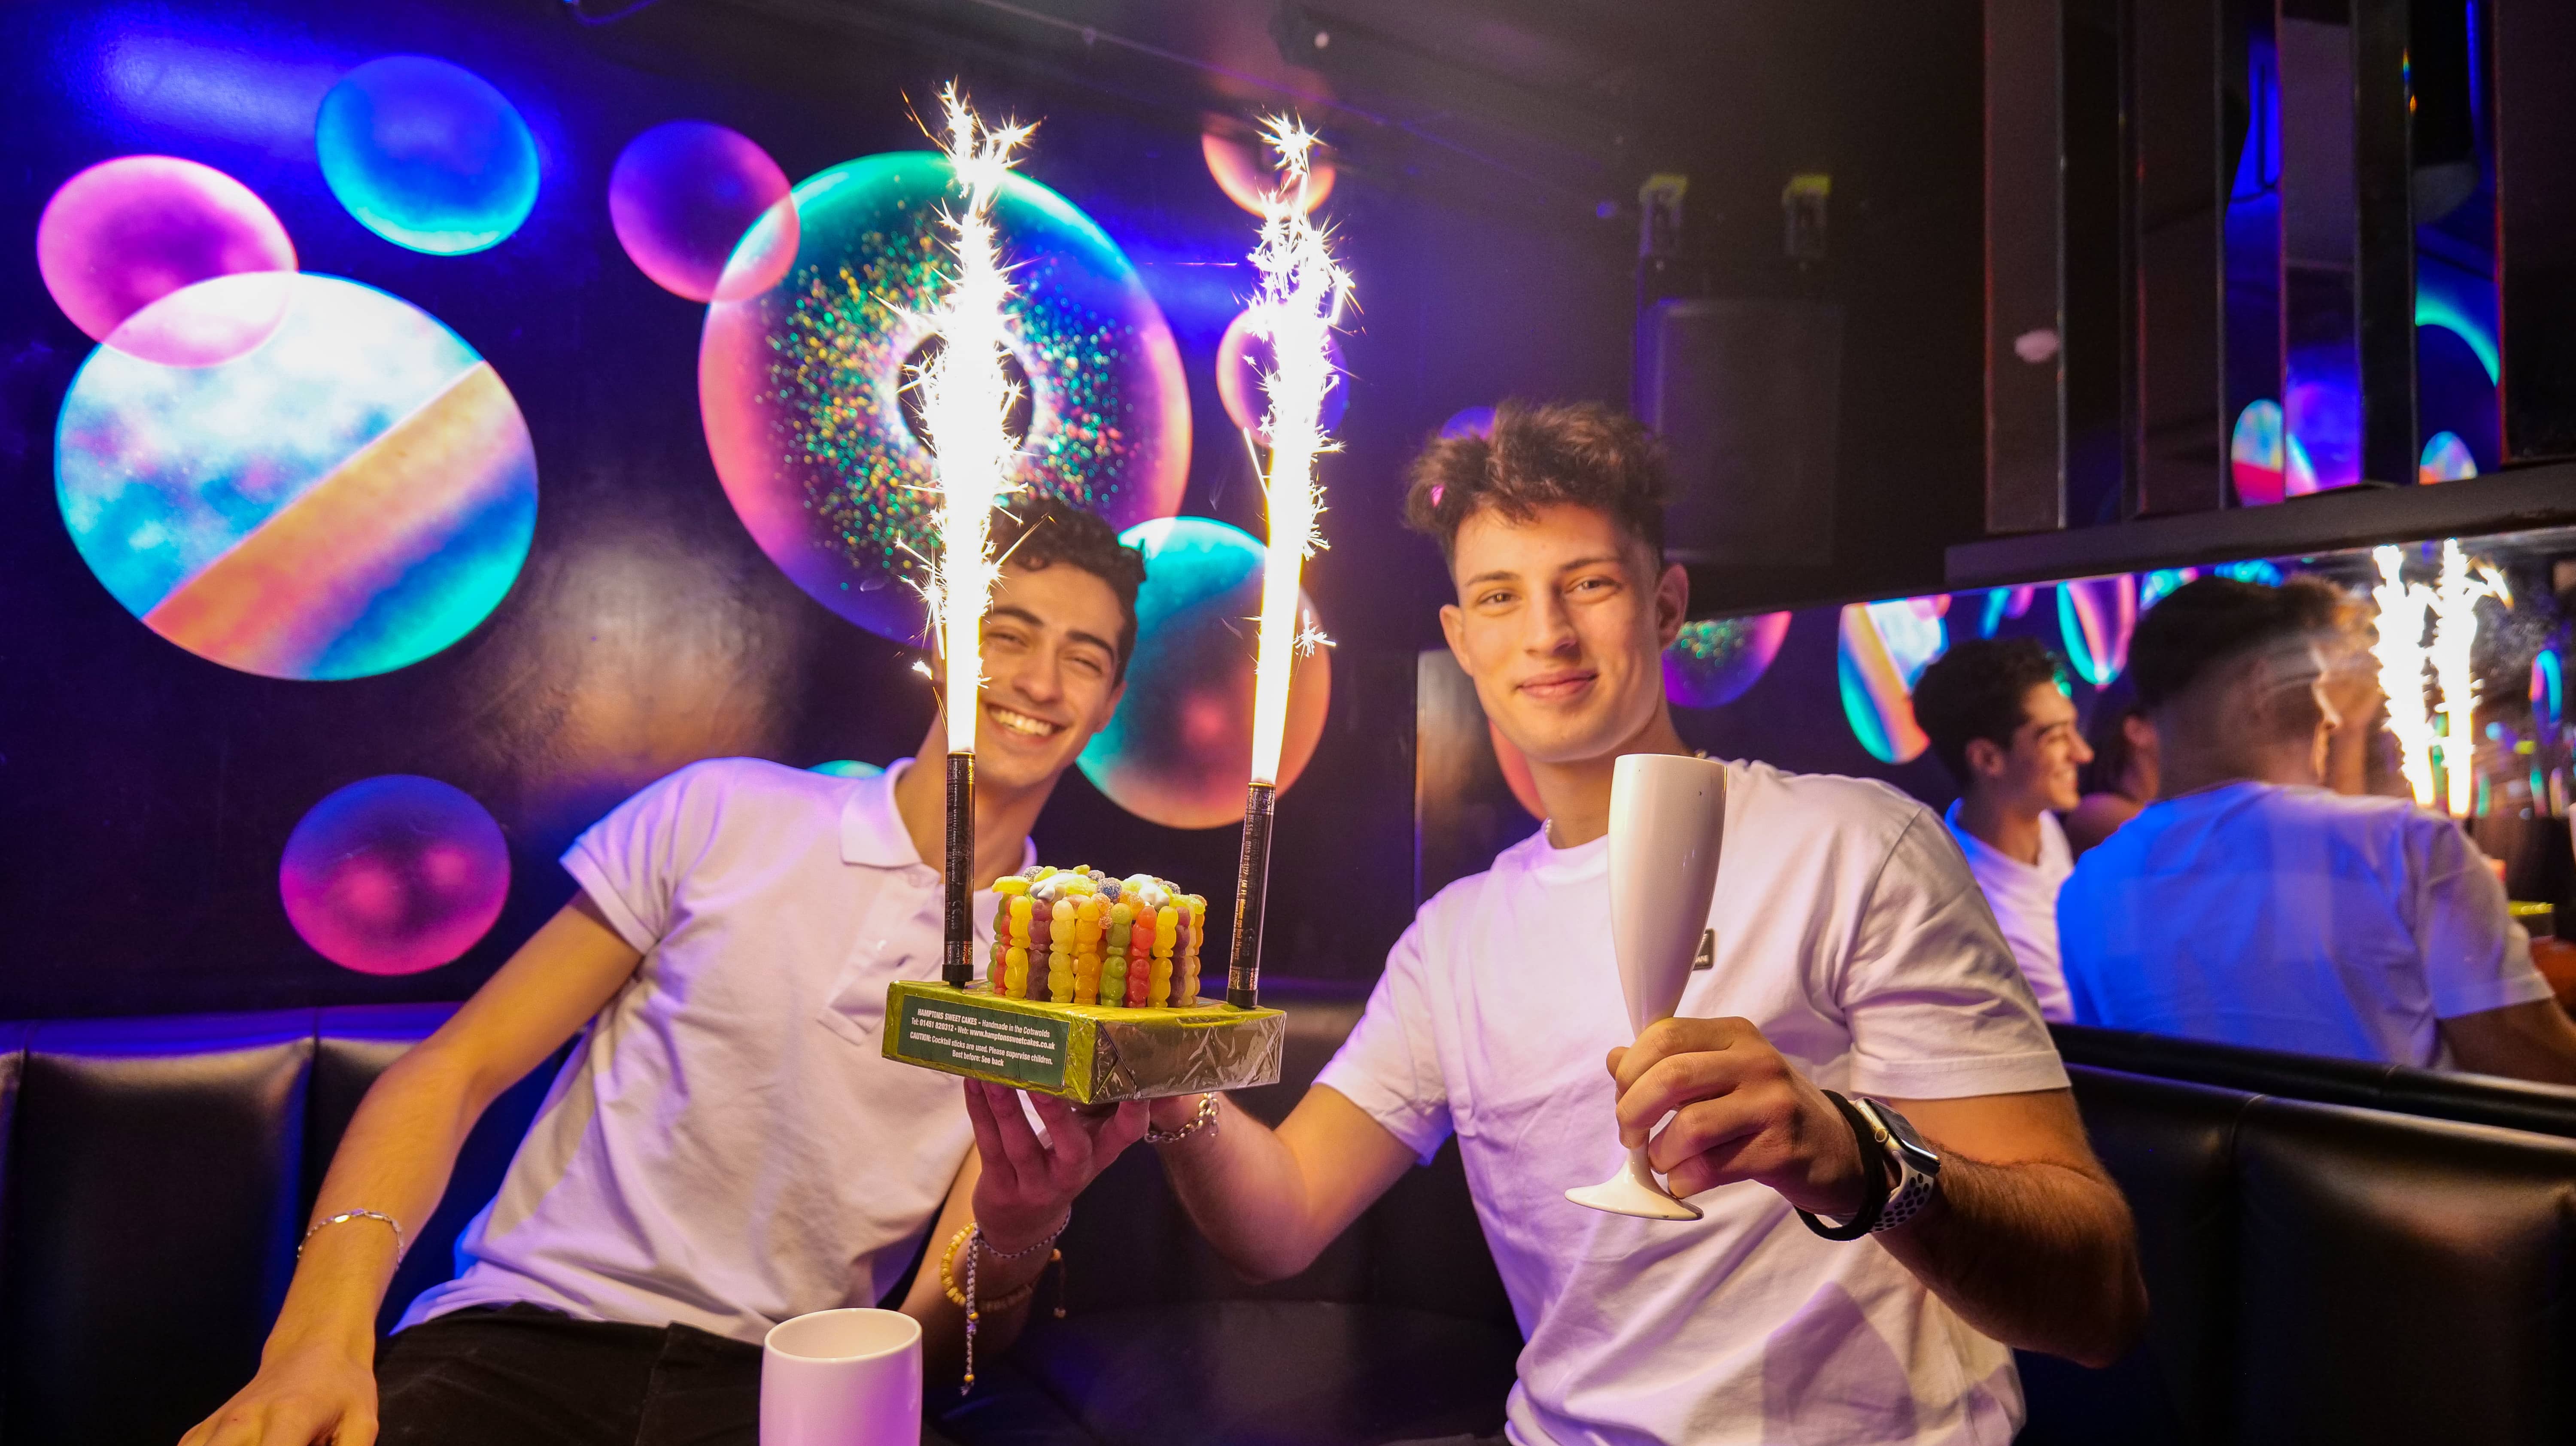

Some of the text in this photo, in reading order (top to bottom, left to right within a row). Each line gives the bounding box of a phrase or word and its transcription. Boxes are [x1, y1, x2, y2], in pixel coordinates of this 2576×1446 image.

[1238, 898, 1247, 918] Minimum
[917, 1008, 944, 1020] HAMPTONS
[945, 1013, 961, 1023] SWEET
[961, 1016, 977, 1025] CAKES
[982, 1019, 1008, 1030] Handmade
[1024, 1027, 1050, 1038] Cotswolds
[920, 1019, 934, 1028] 01451
[935, 1022, 954, 1032] 820312
[957, 1026, 969, 1035] Web:
[969, 1029, 1055, 1050] www.hamptonssweetcakes.co.uk
[910, 1031, 931, 1042] CAUTION:
[932, 1036, 951, 1045] Cocktail
[951, 1040, 965, 1050] sticks
[989, 1046, 1005, 1056] Please
[1006, 1050, 1030, 1060] supervise
[1031, 1054, 1053, 1065] children.
[952, 1050, 1004, 1066] Best before: See back
